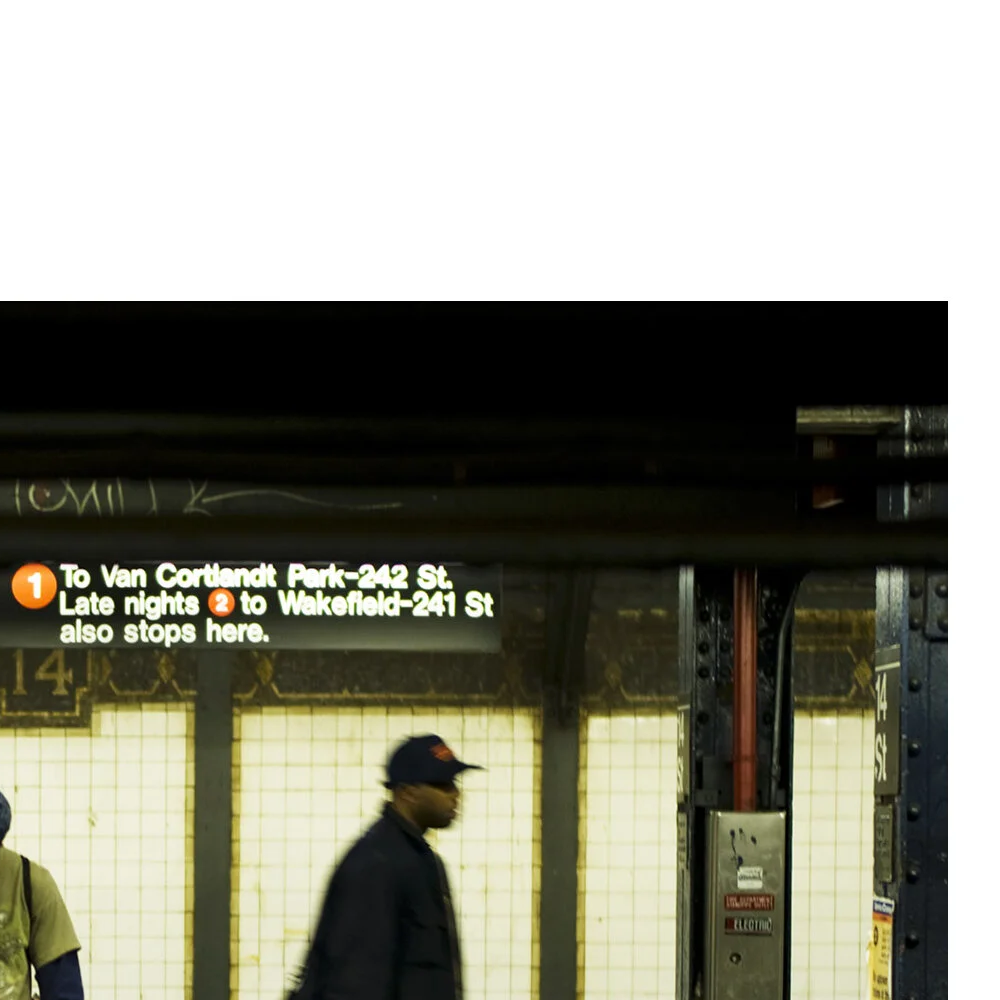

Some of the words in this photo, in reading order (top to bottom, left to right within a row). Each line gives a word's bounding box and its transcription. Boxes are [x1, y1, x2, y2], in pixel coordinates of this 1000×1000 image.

[27, 572, 42, 599] 1
[60, 564, 91, 589] To
[101, 564, 146, 589] Van
[155, 563, 278, 589] Cortlandt
[416, 564, 453, 590] St.
[60, 591, 115, 616] Late
[125, 590, 200, 621] nights
[214, 592, 229, 613] 2
[240, 592, 267, 616] to
[465, 591, 494, 618] St
[60, 620, 114, 644] also
[124, 622, 197, 648] stops
[206, 618, 270, 644] here.
[13, 649, 74, 696] 14
[875, 671, 888, 723] 14
[875, 732, 888, 783] St
